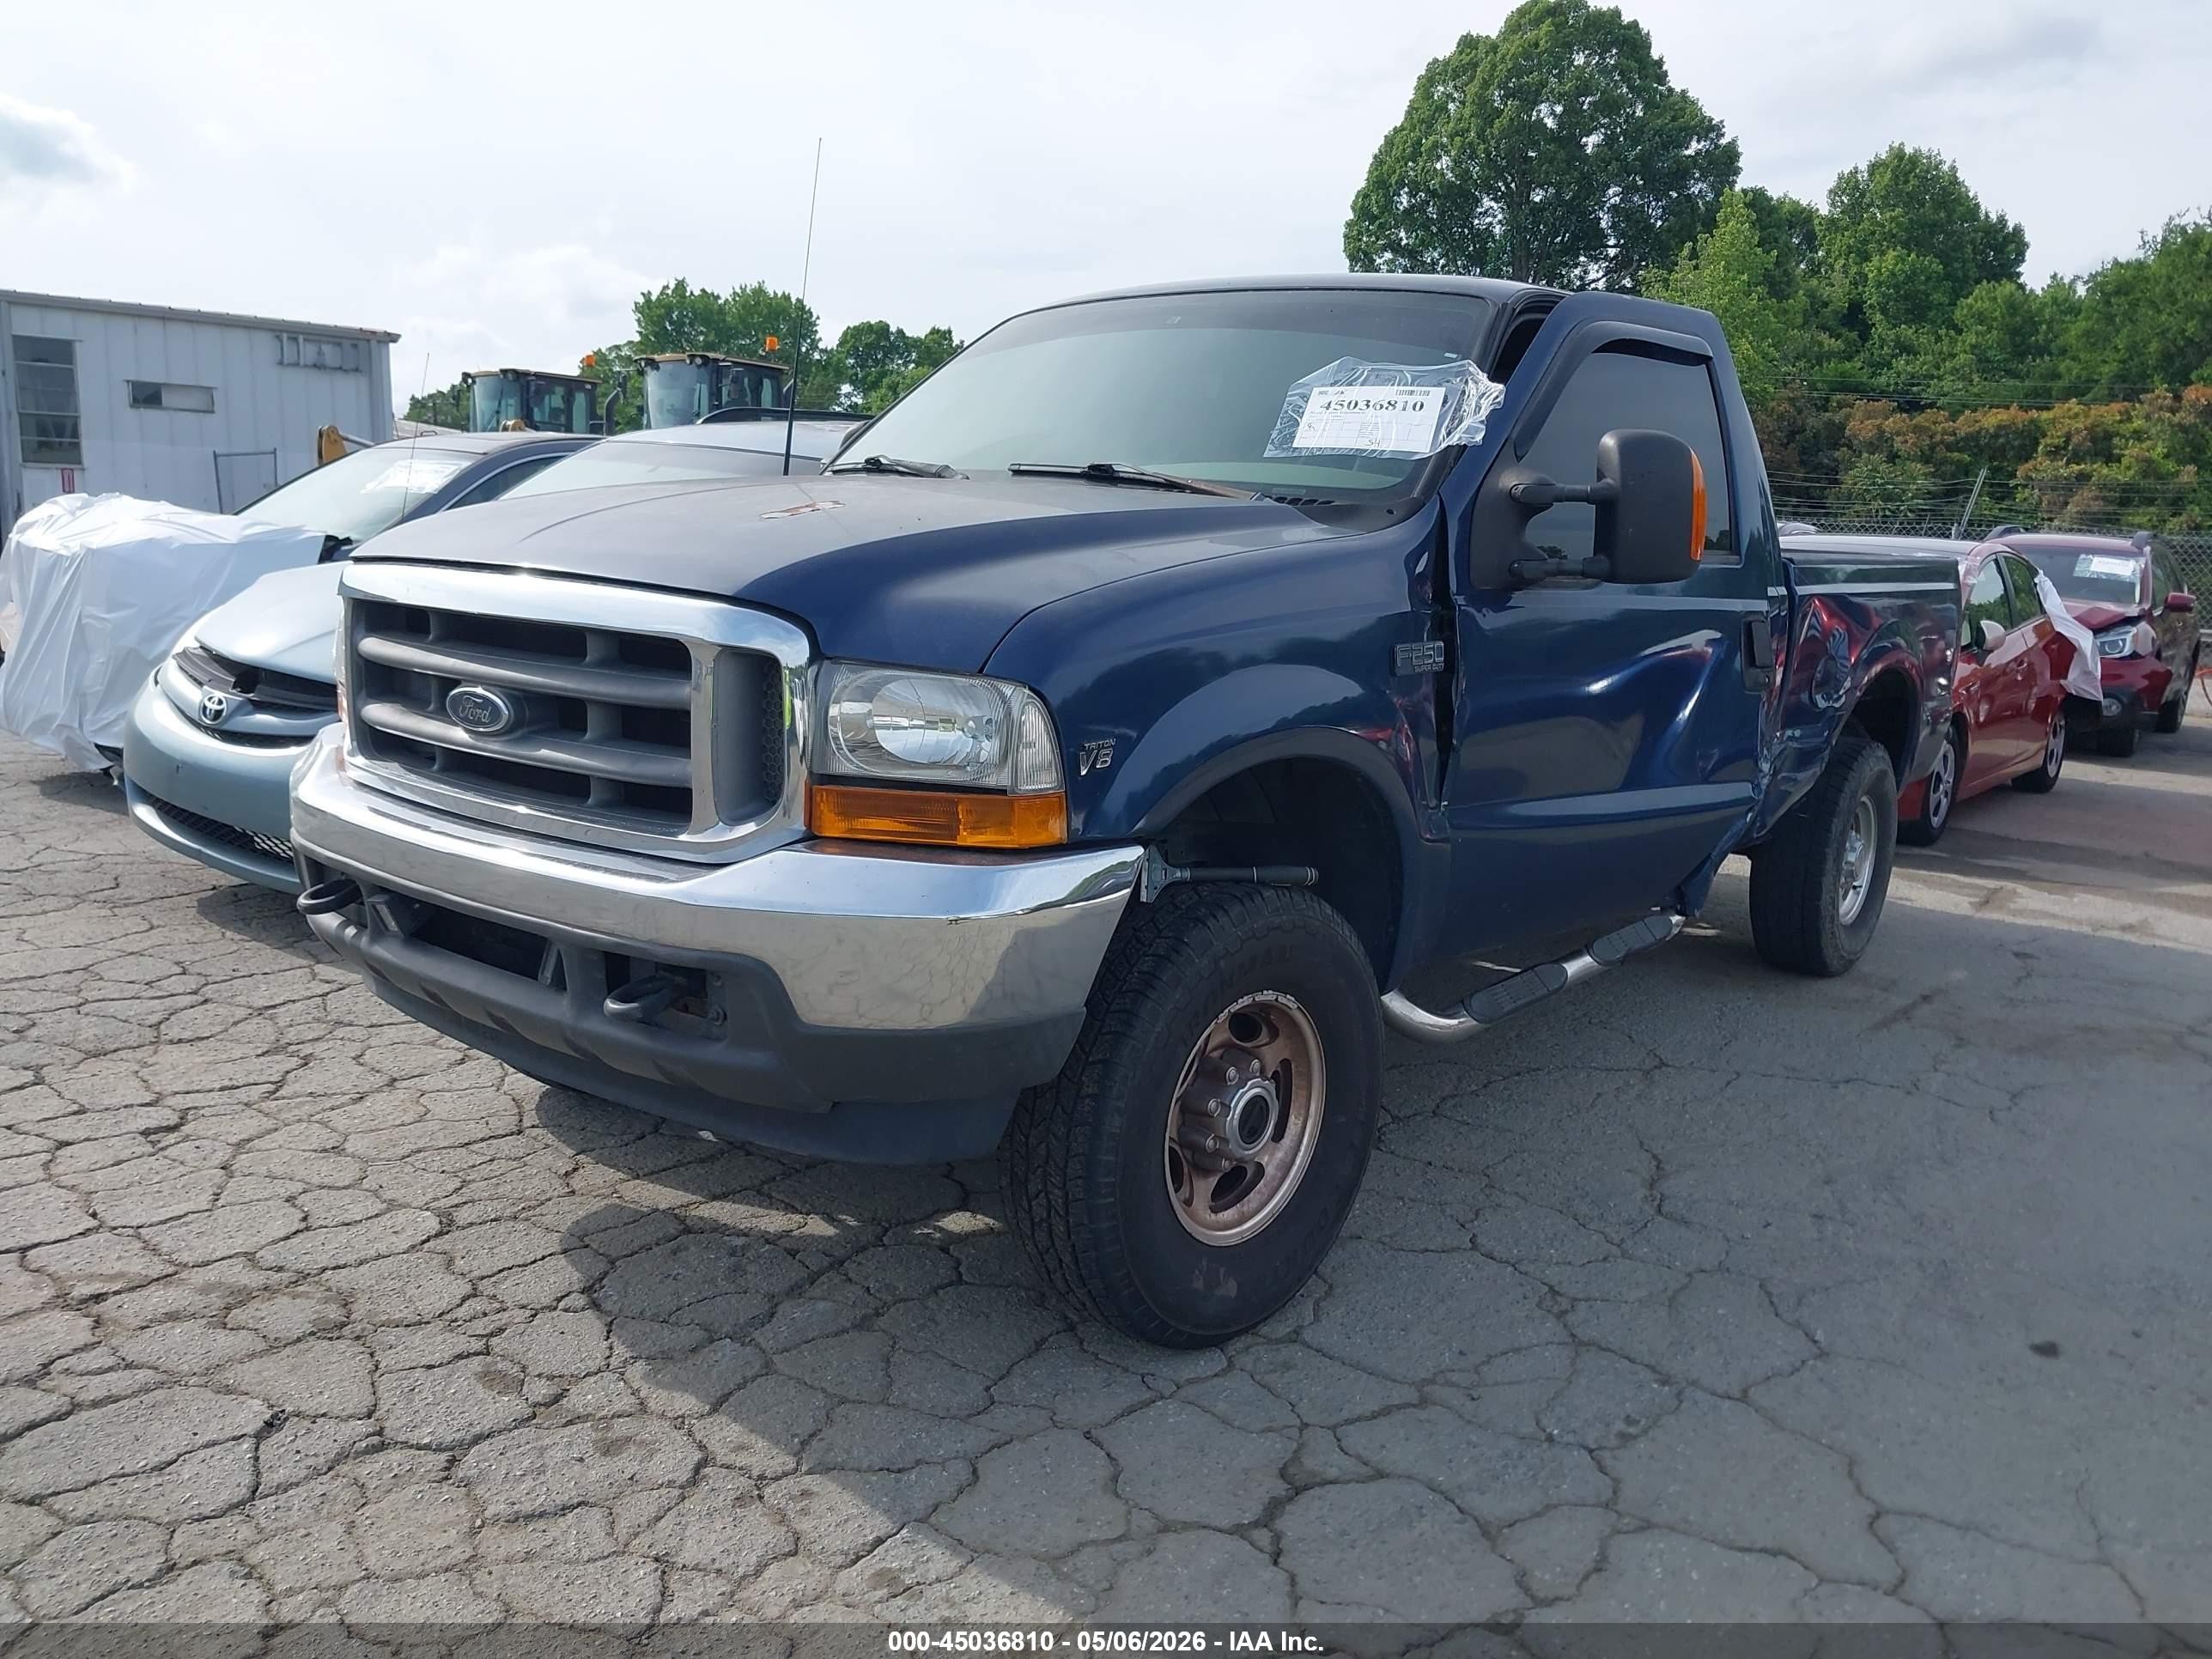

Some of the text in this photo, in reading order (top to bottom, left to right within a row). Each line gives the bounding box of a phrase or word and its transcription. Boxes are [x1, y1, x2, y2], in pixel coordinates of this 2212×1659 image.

[1320, 398, 1425, 413] 45036810
[459, 695, 492, 723] Ford
[1079, 748, 1114, 776] V8
